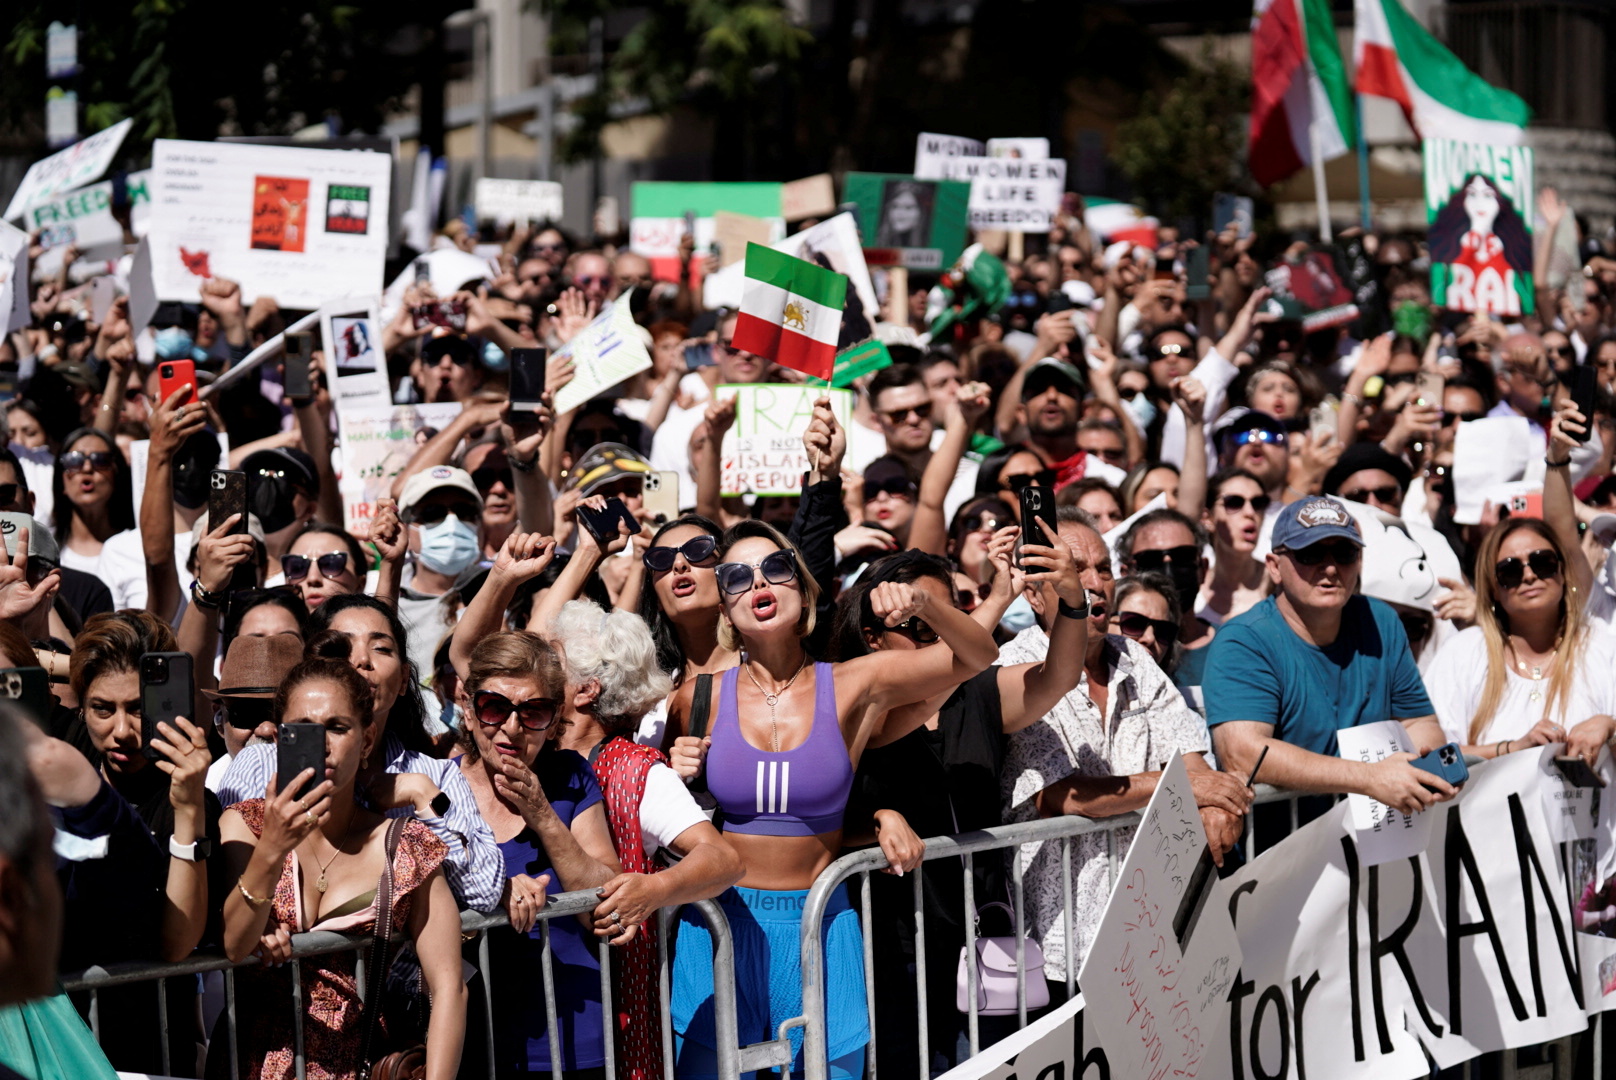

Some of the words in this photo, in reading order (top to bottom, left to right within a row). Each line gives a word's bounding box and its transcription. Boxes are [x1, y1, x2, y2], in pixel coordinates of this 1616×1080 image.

[34, 179, 150, 227] FREEDM
[1423, 138, 1534, 228] WOMEN
[736, 471, 804, 489] REPU
[1341, 792, 1585, 1062] IRAN
